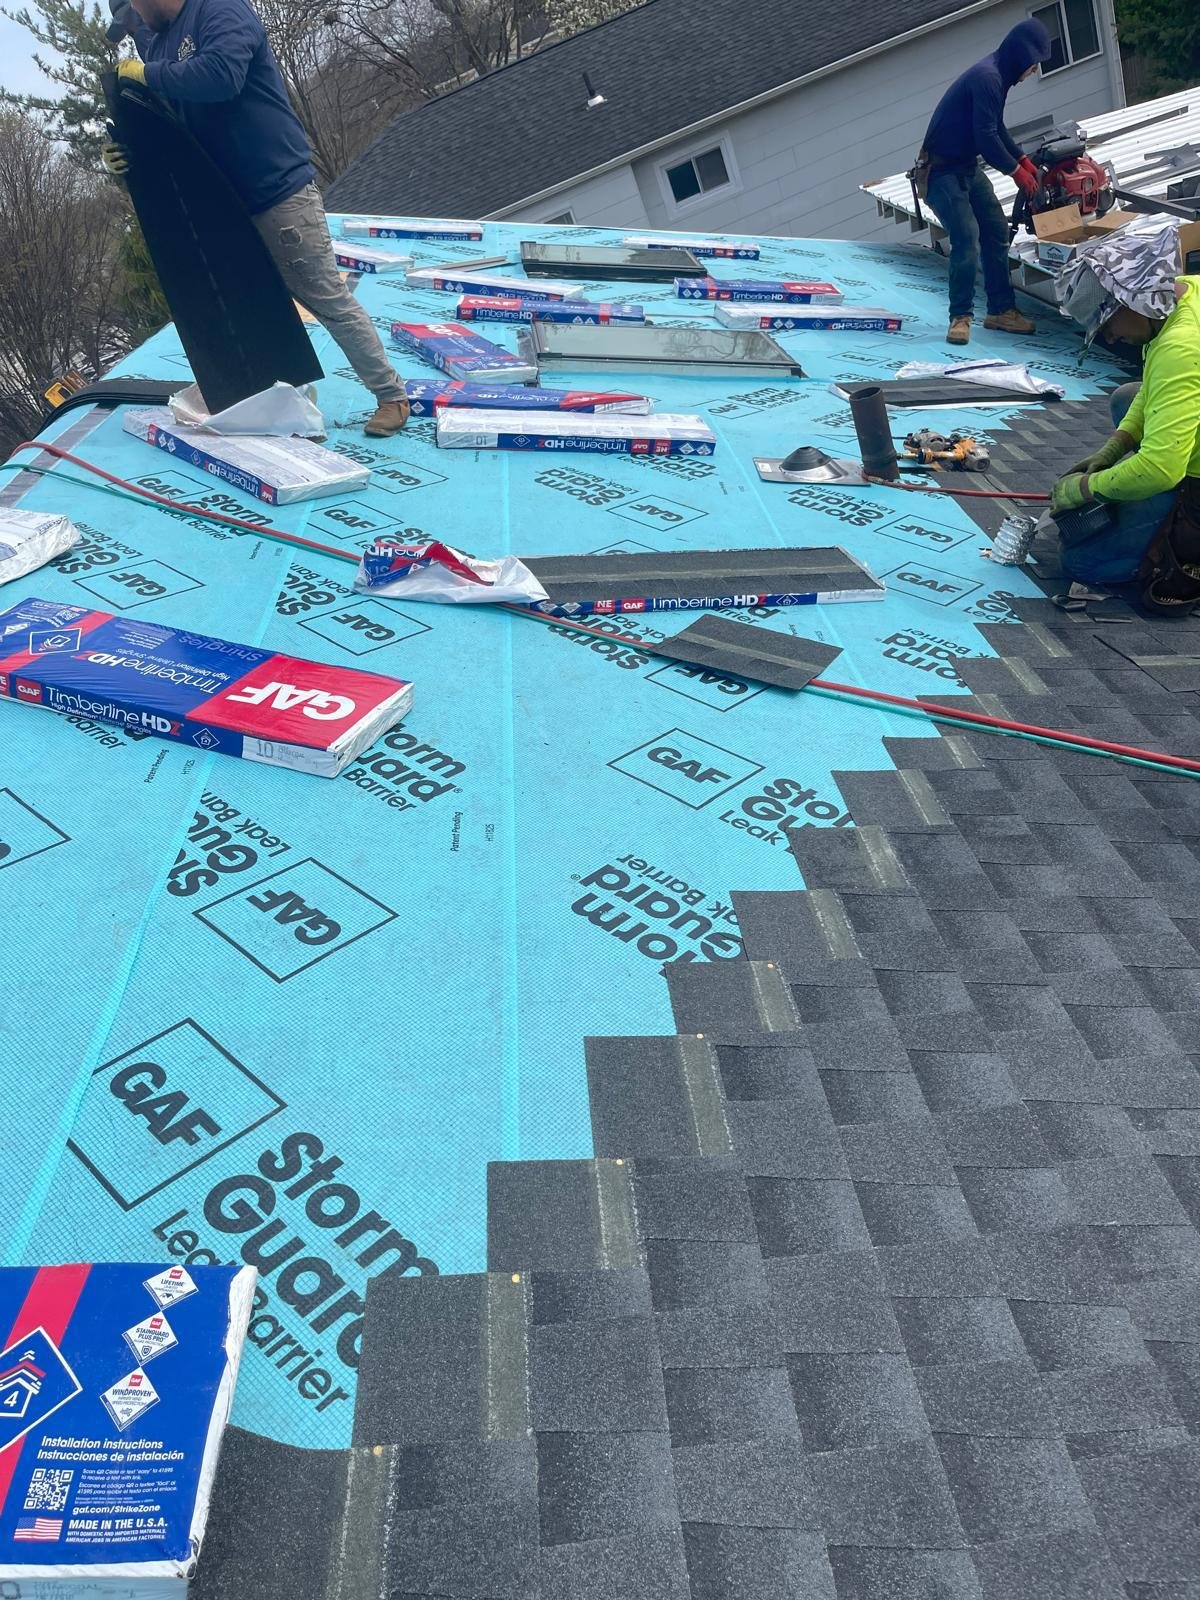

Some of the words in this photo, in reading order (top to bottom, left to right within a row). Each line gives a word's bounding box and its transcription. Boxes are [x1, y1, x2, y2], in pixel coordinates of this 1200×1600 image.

[708, 403, 742, 414] GAF
[632, 442, 649, 450] GAF
[666, 453, 717, 471] orm
[137, 477, 187, 497] GAF
[373, 469, 421, 486] GAF
[540, 469, 625, 500] Guard
[534, 476, 611, 506] Storm
[201, 494, 274, 526] Storm
[629, 504, 684, 522] GAF
[788, 496, 872, 527] Storm
[789, 488, 884, 519] Guard
[324, 509, 376, 529] GAF
[894, 524, 953, 543] GAF
[108, 541, 144, 560] Leak
[108, 572, 167, 596] GAF
[318, 578, 357, 599] Leak
[897, 572, 963, 593] GAF
[597, 600, 612, 608] NE
[623, 602, 644, 610] GAF
[963, 606, 1013, 624] Leak
[331, 613, 395, 641] GAF
[881, 632, 958, 660] ard
[902, 628, 972, 655] Barrier
[212, 670, 231, 681] High
[674, 665, 749, 695] GAF
[17, 685, 41, 697] GAF
[225, 681, 356, 721] GAF
[46, 686, 183, 737] TimberlineHDZ
[51, 702, 66, 711] High
[256, 739, 274, 758] 10
[381, 722, 466, 779] orm
[355, 746, 457, 802] uard
[647, 746, 732, 784] GAF
[342, 768, 417, 812] Barrier
[451, 811, 464, 832] Pending
[718, 810, 784, 846] Leak
[233, 818, 292, 858] Leak
[450, 833, 460, 852] Patent
[617, 854, 706, 907] Barrier
[246, 889, 342, 946] GAF
[109, 1061, 222, 1145] GAF
[257, 1132, 440, 1278] Storm
[151, 1208, 238, 1266] Lea
[160, 1279, 185, 1287] LIFETIME
[7, 1390, 17, 1406] 4
[112, 1388, 152, 1397] WINDPROVEN
[41, 1436, 101, 1449] Installation
[103, 1438, 164, 1450] instructions
[37, 1449, 108, 1461] Instrucciones
[110, 1452, 124, 1462] de
[126, 1450, 184, 1461] instalación
[72, 1504, 160, 1515] gaf.com/StrikeZone
[69, 1519, 98, 1529] MADE
[101, 1519, 111, 1529] IN
[115, 1518, 133, 1529] THE
[136, 1517, 168, 1527] U.S.A.
